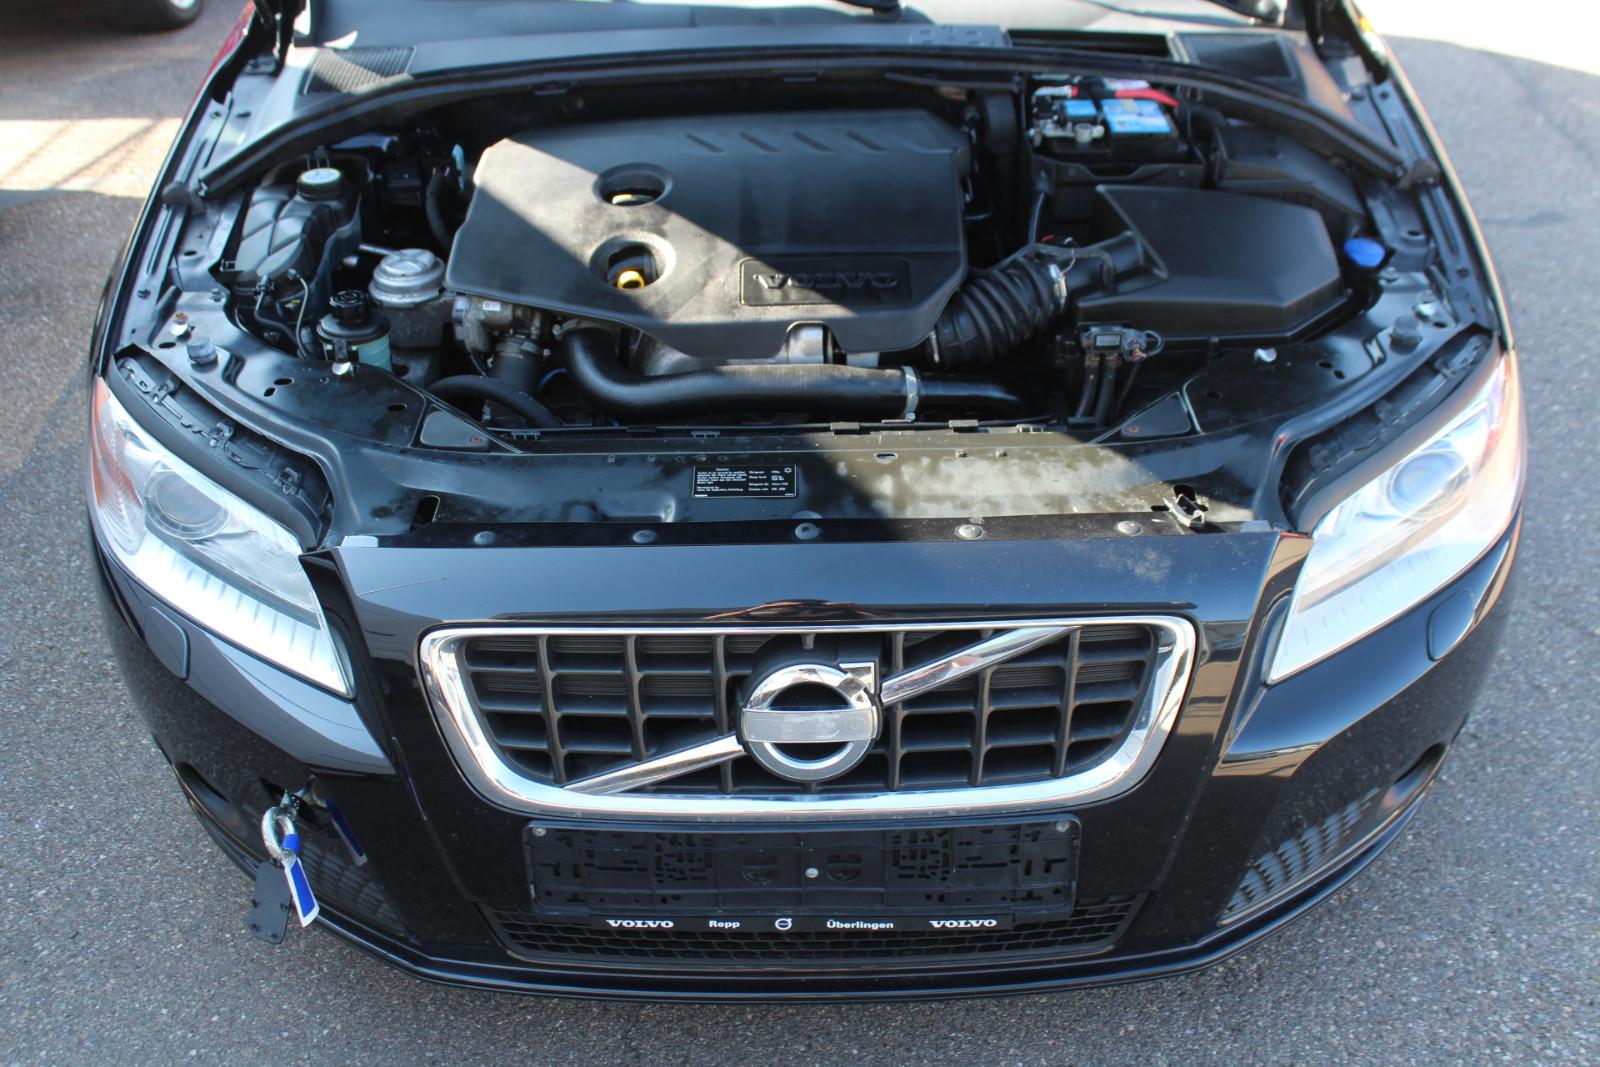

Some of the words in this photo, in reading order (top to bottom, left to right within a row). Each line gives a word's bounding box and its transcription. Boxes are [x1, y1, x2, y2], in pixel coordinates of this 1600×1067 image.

[753, 273, 899, 289] VOLVO
[606, 919, 675, 929] VOLVO
[708, 919, 741, 930] Repp
[826, 918, 895, 931] Überlingen
[929, 918, 998, 929] VOLVO
